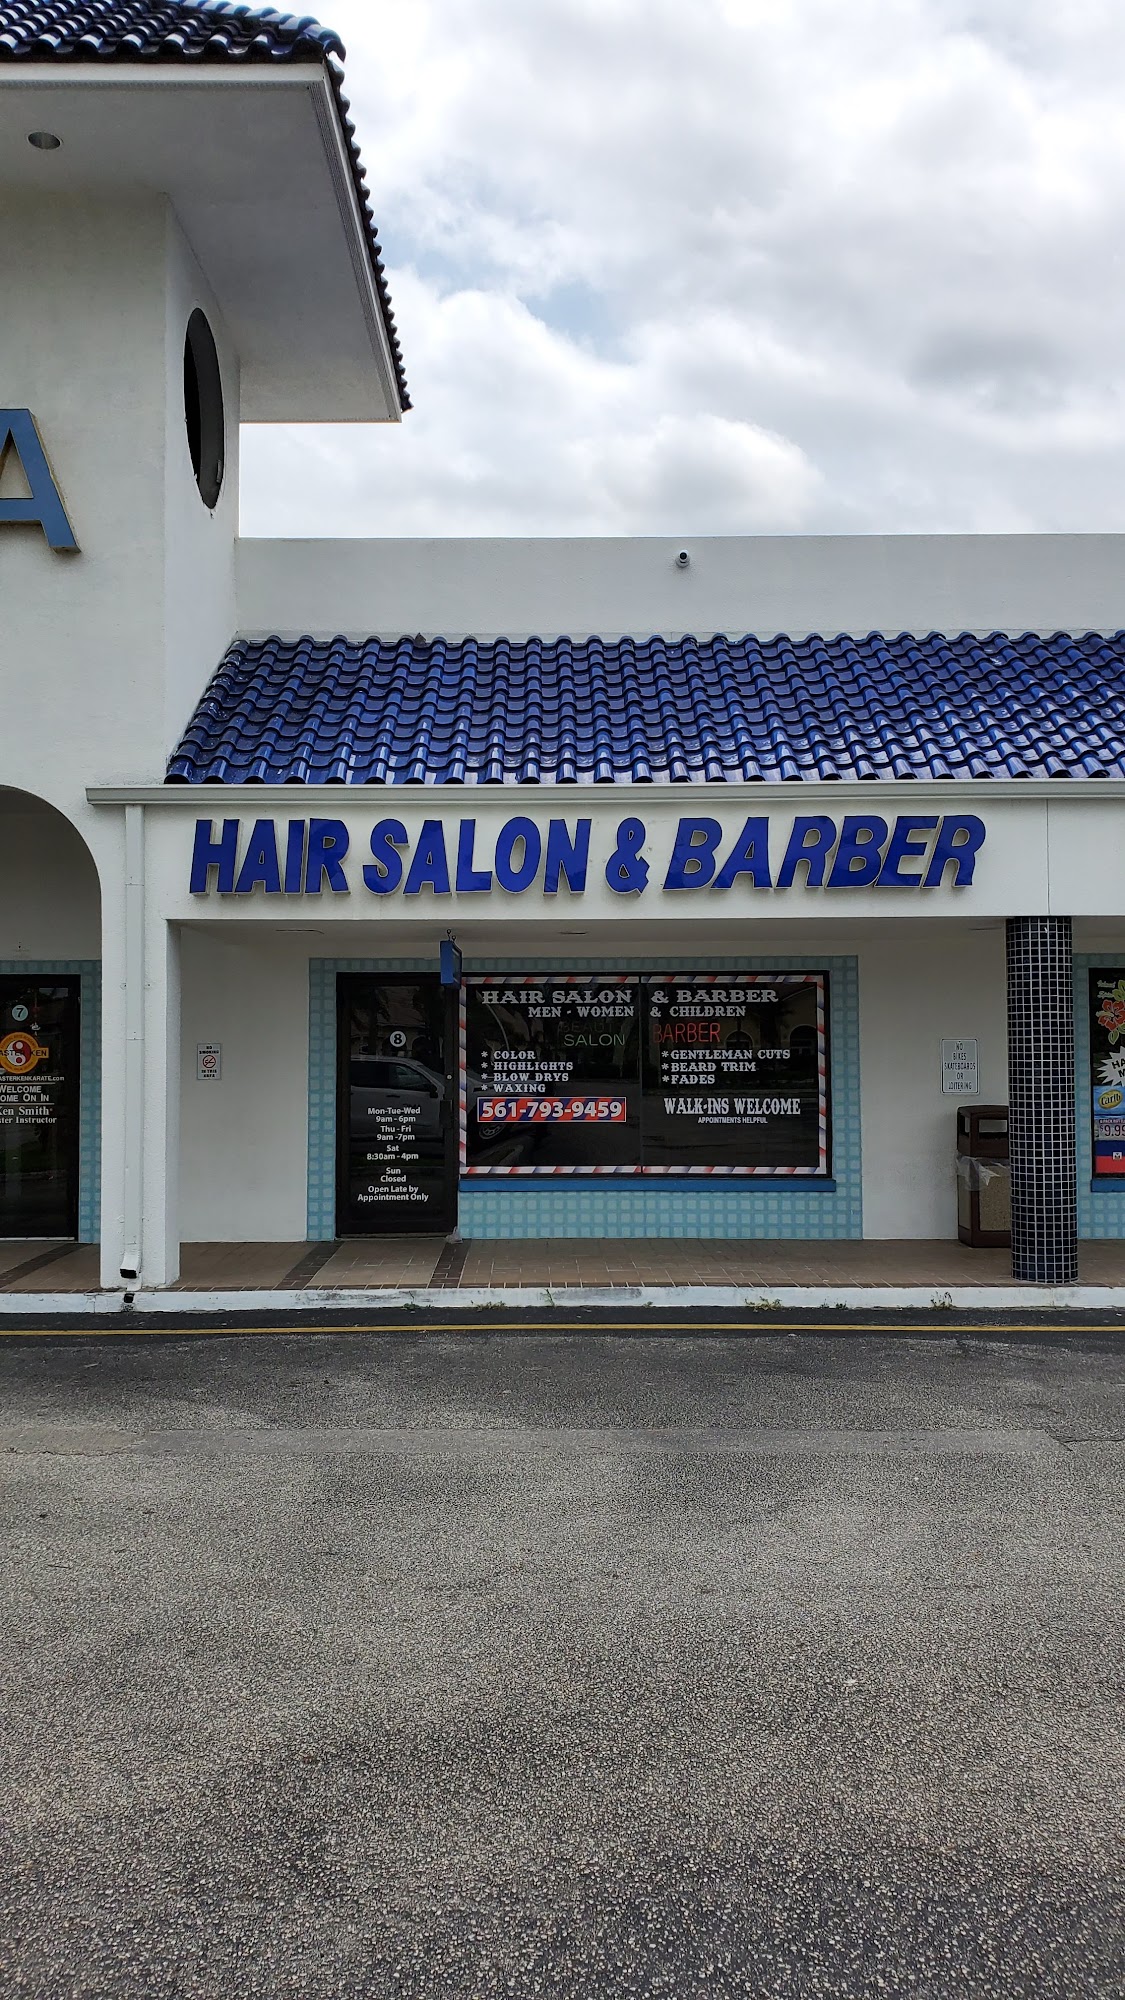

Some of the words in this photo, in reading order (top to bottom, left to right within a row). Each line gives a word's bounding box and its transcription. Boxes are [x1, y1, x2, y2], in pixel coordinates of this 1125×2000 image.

[0, 408, 81, 553] A
[189, 817, 351, 895] HAIR
[362, 816, 592, 895] SALON
[605, 817, 651, 895] &
[662, 814, 987, 892] BARBER
[481, 990, 546, 1004] HAIR
[552, 990, 632, 1003] SALON
[651, 990, 669, 1003] &
[676, 989, 779, 1003] BARBER
[528, 1006, 562, 1018] MEN
[576, 1006, 634, 1017] WOMEN
[650, 1007, 662, 1017] &
[669, 1005, 746, 1017] CHILDREN
[653, 1022, 721, 1044] BARBER
[563, 1033, 625, 1047] SALON
[955, 1042, 964, 1051] NO
[31, 1049, 47, 1057] KEN
[493, 1050, 536, 1060] COLOR
[670, 1049, 753, 1060] GENTLEMAN
[757, 1049, 791, 1059] CUTS
[953, 1052, 967, 1061] BIKES
[493, 1061, 574, 1071] HIGHLIGHTS
[670, 1062, 717, 1072] BEARD
[721, 1062, 757, 1072] TRIM
[944, 1062, 976, 1070] SKATEBOARDS
[493, 1072, 530, 1082] BLOW
[535, 1072, 569, 1082] DRYS
[671, 1074, 715, 1085] FADES
[956, 1072, 964, 1080] OR
[493, 1083, 546, 1093] WAXING
[948, 1082, 972, 1090] LOITERING
[18, 1105, 50, 1116] Smith
[367, 1107, 421, 1115] Mon-Tue-Wed
[482, 1101, 622, 1118] 561-793-9459
[664, 1098, 729, 1115] WALK-INS
[734, 1098, 801, 1115] WELCOME
[15, 1116, 58, 1124] Instructor
[375, 1115, 393, 1123] 9am
[398, 1115, 416, 1124] 6pm
[380, 1125, 396, 1133] Thu
[401, 1125, 412, 1133] Fri
[376, 1133, 394, 1141] 9am
[386, 1144, 400, 1152] Sat
[366, 1153, 396, 1161] 8:30am
[400, 1152, 419, 1161] 4pm
[385, 1167, 402, 1175] Sun
[380, 1175, 407, 1183] Closed
[367, 1185, 389, 1194] Open
[390, 1185, 407, 1193] Late
[408, 1185, 419, 1194] by
[357, 1194, 409, 1203] Appointment
[410, 1193, 429, 1203] Only
